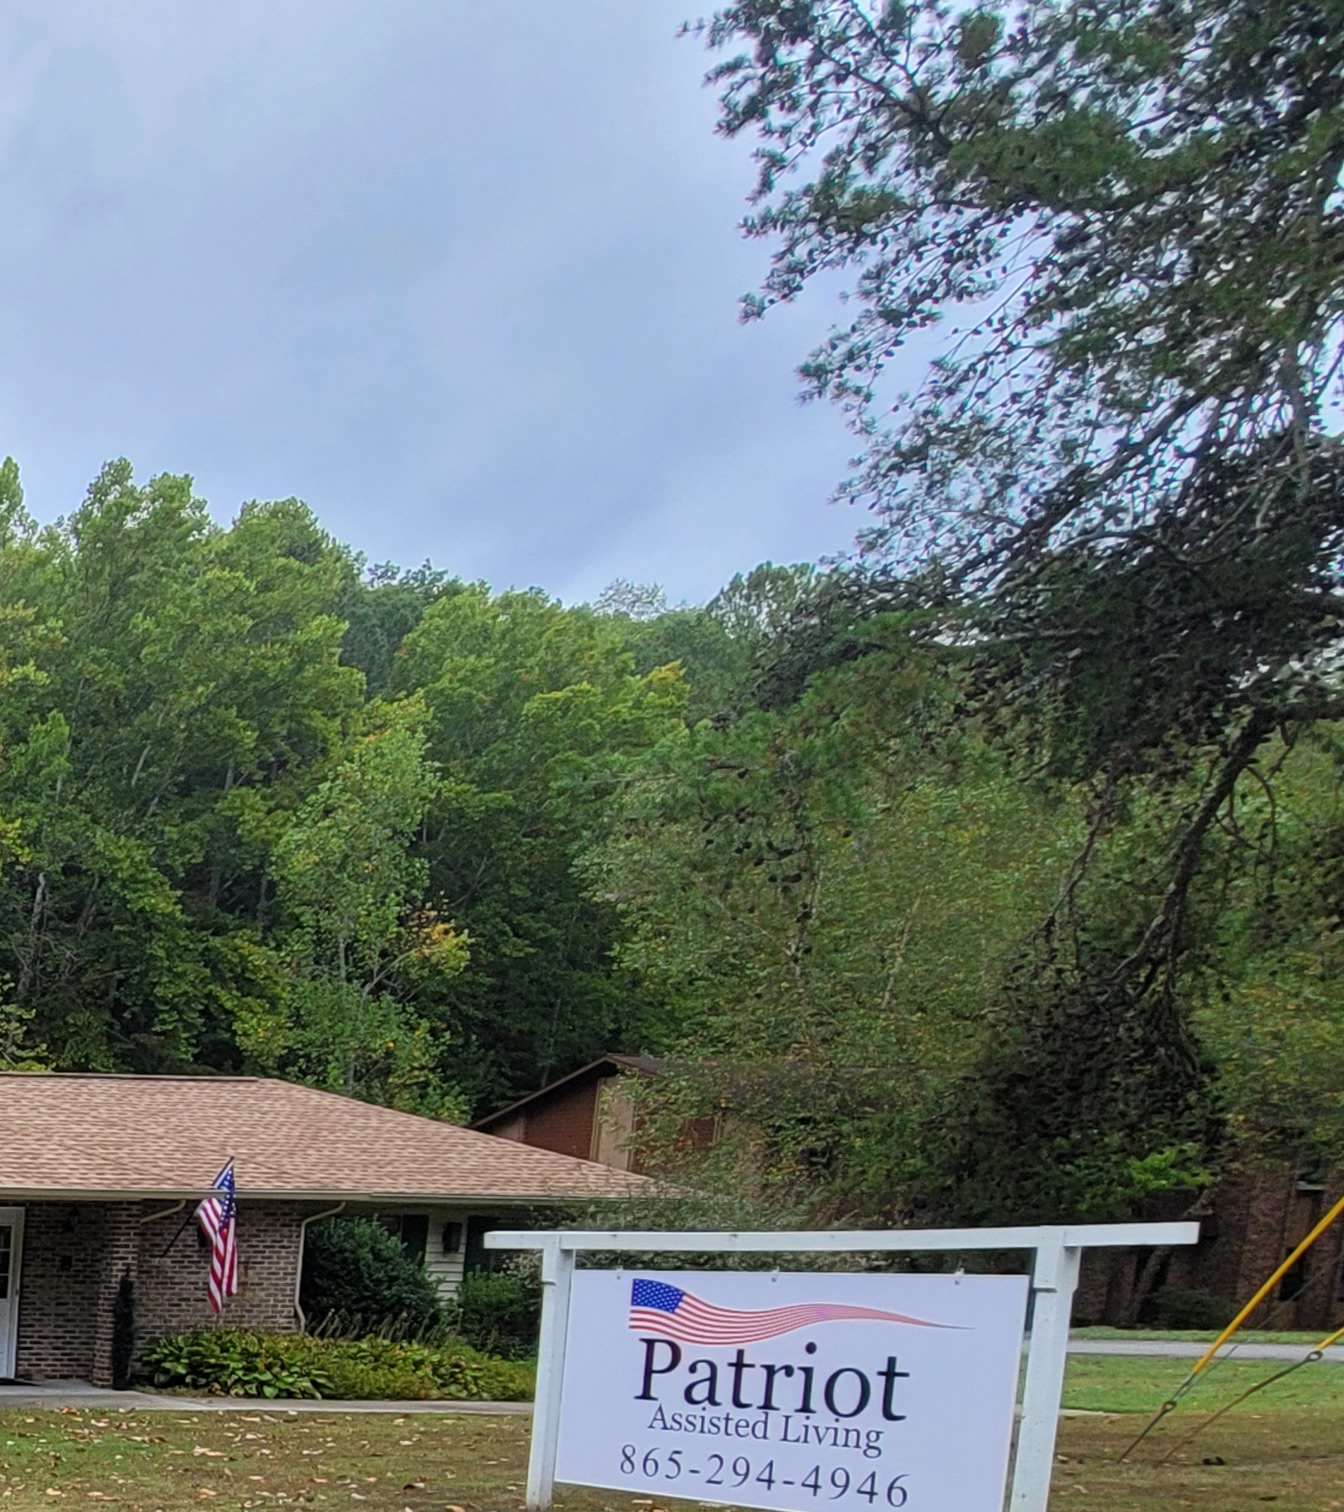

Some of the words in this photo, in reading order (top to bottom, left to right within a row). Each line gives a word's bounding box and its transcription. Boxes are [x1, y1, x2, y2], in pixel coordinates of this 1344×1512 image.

[633, 1337, 910, 1422] Patriot
[647, 1404, 769, 1440] Assisted
[779, 1413, 884, 1459] Living
[619, 1444, 911, 1508] 865-294-4946
